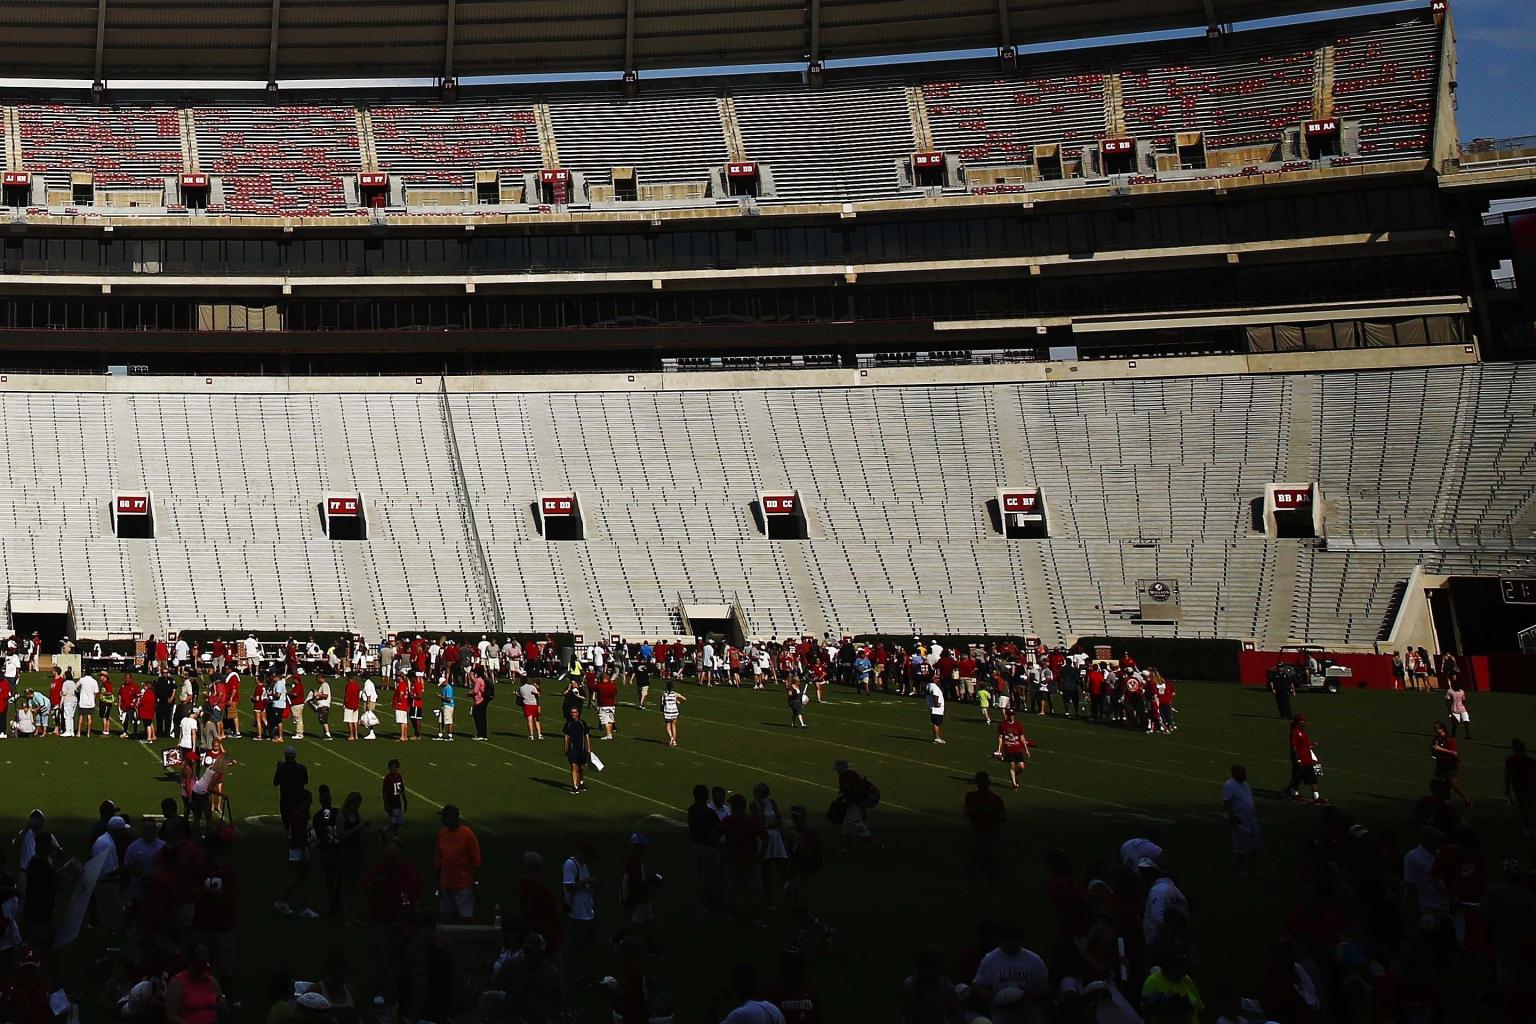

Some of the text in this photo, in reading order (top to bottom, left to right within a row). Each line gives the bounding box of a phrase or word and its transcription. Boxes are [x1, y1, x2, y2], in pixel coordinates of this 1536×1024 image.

[1324, 122, 1335, 130] AA
[1278, 494, 1292, 502] BB
[766, 500, 792, 508] DD CC
